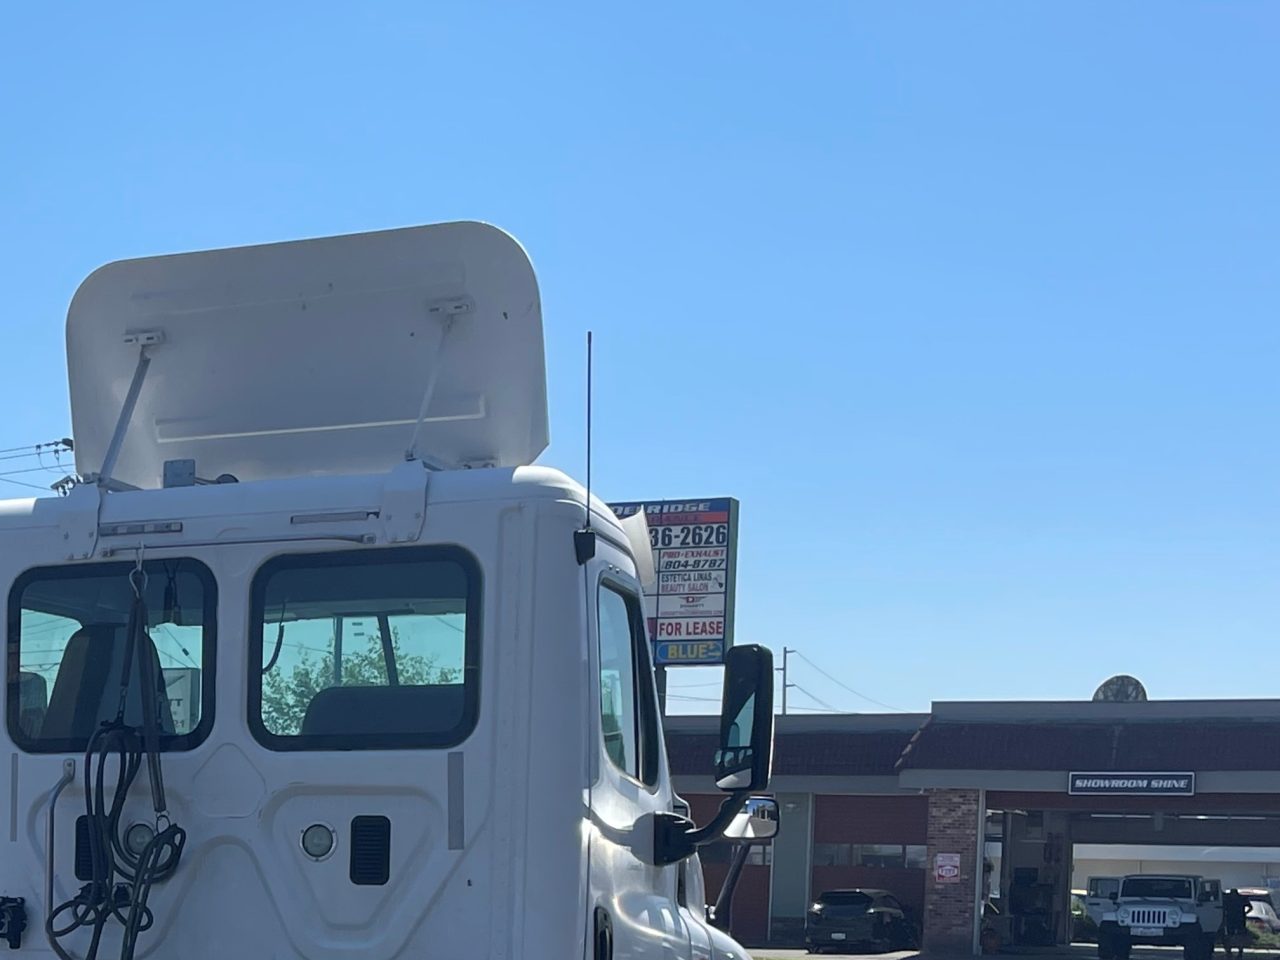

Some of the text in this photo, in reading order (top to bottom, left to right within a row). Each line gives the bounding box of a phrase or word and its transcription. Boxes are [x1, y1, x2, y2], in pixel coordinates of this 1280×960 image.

[661, 573, 691, 583] ESTETICA
[661, 582, 709, 593] BEAUTY SALON
[659, 621, 723, 636] FOR LEASE
[1075, 779, 1188, 788] SHOWROOM SHINE
